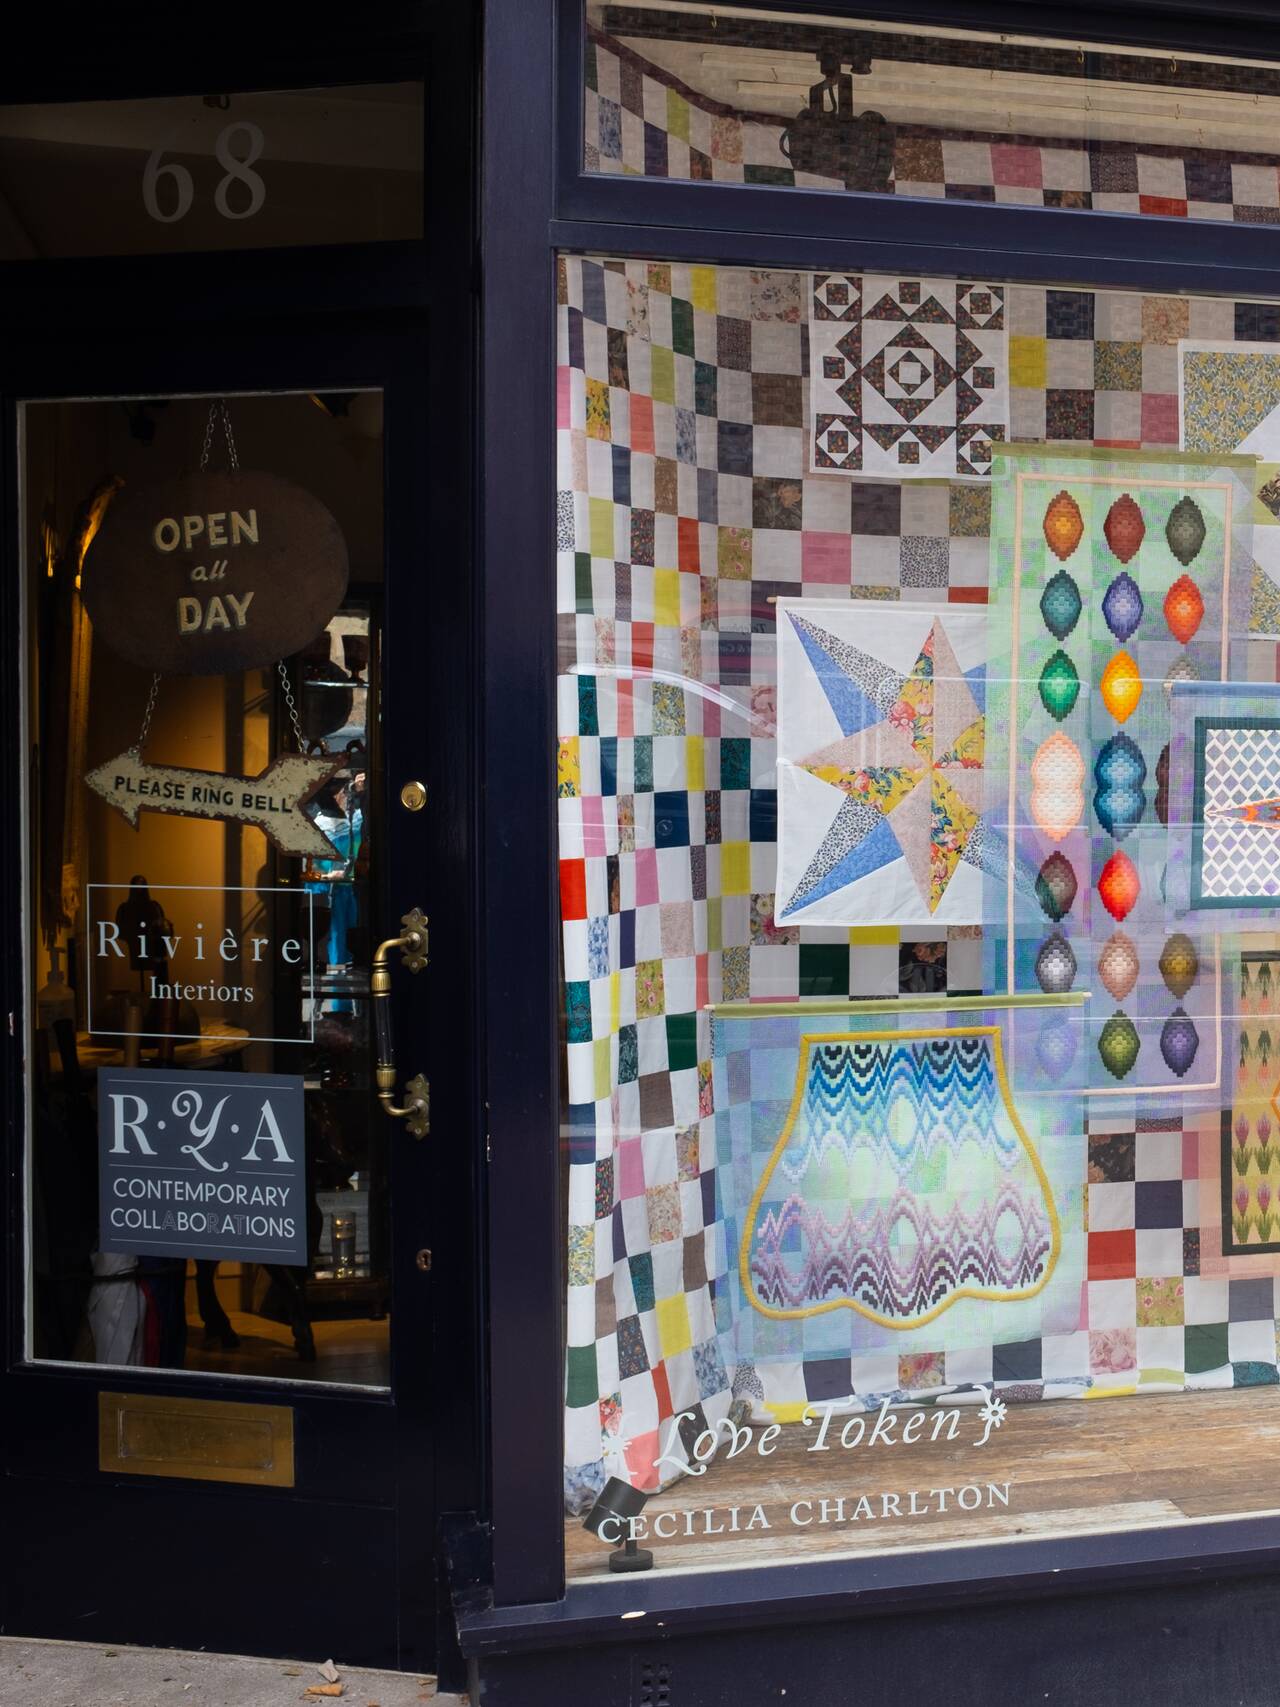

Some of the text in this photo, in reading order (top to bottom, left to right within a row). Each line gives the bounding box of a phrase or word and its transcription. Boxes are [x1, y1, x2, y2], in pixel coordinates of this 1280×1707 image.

[142, 121, 267, 222] 68
[154, 508, 260, 552] OPEN
[190, 560, 227, 582] all
[177, 591, 256, 636] DAY
[113, 775, 293, 814] PLEASE RING BELL
[97, 921, 301, 964] Rivière
[149, 976, 255, 1003] Interiors
[112, 1177, 291, 1207] CONTEMPORARY
[110, 1208, 296, 1239] COLLABORATIONS
[652, 1396, 962, 1476] Love Token
[597, 1482, 1013, 1544] CECILIA CHARLTON
